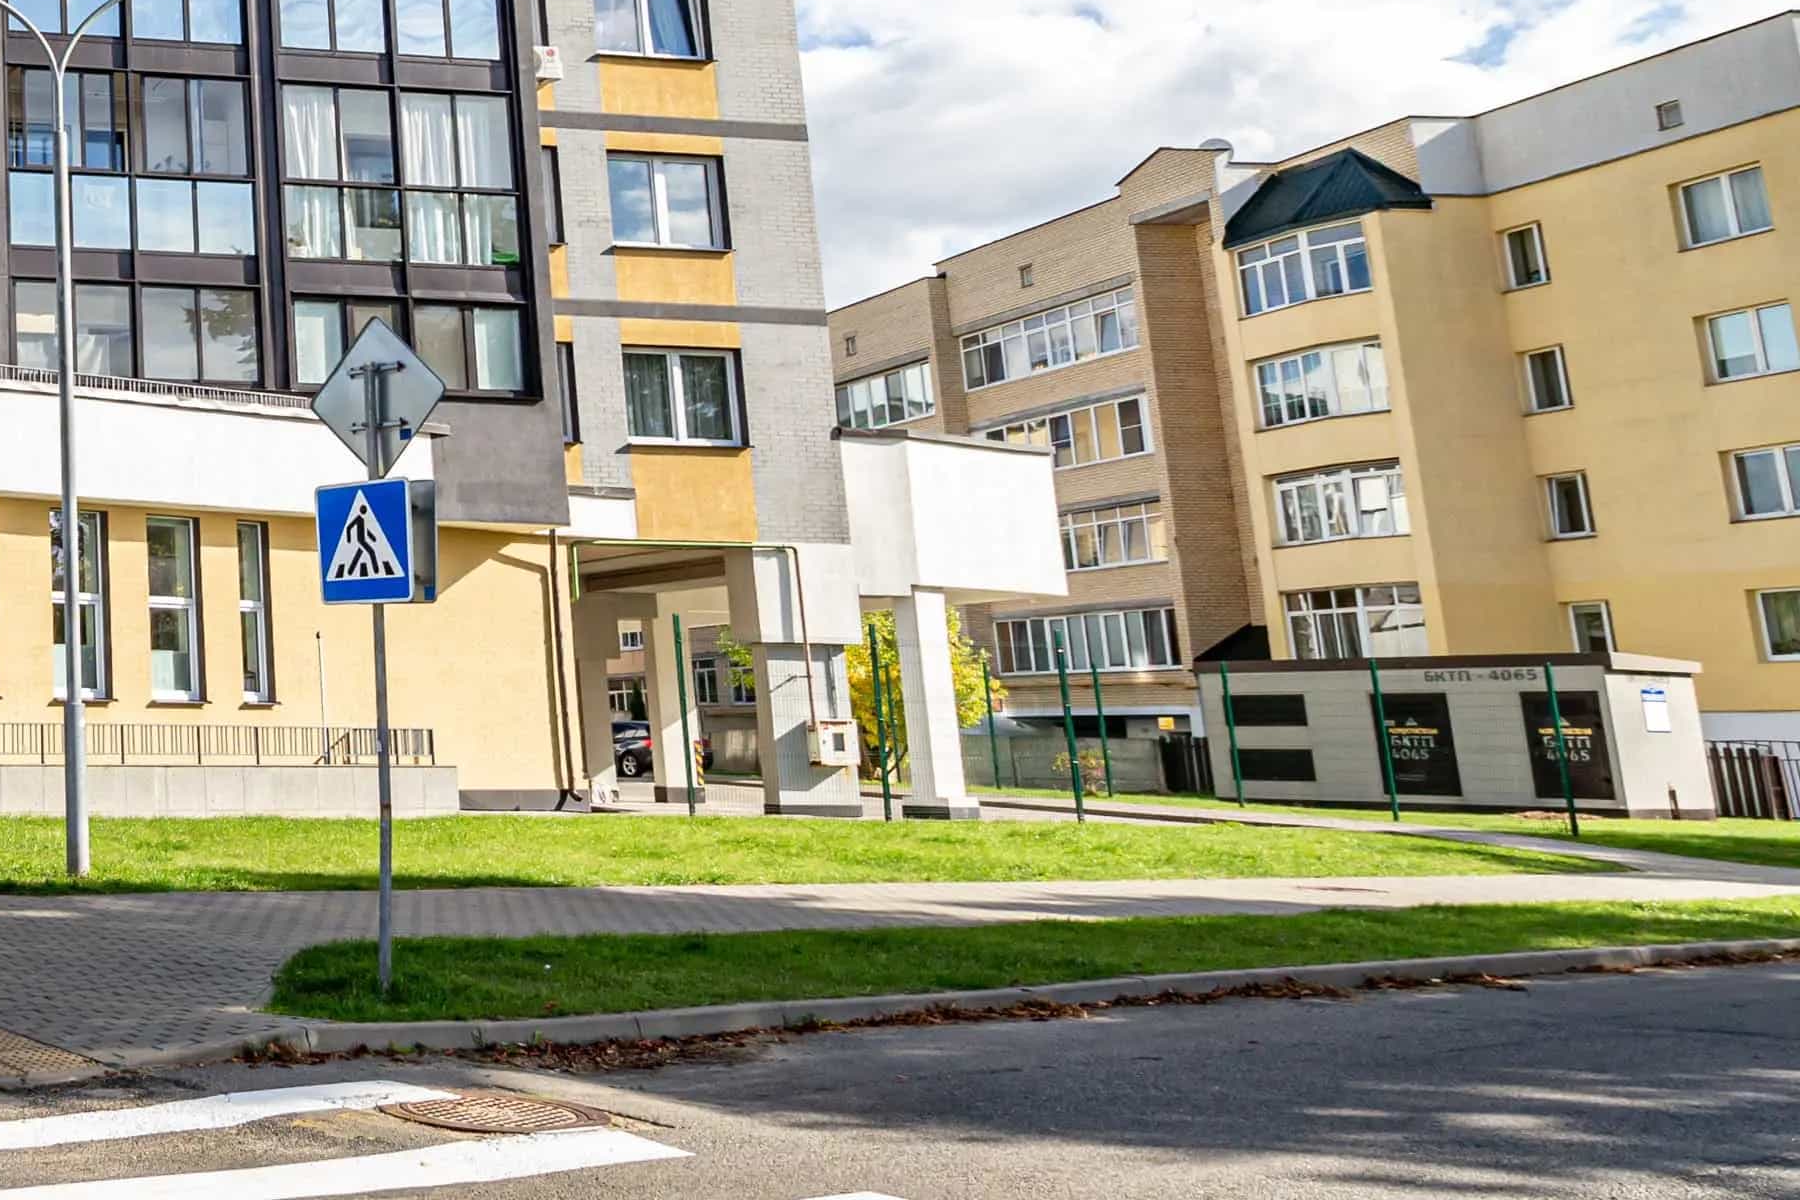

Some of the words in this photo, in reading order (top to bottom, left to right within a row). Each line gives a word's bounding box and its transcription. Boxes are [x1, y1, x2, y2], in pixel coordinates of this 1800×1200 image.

[1423, 670, 1472, 682] БКТП
[1488, 669, 1537, 681] 4065
[1391, 735, 1435, 748] БКТП
[1542, 736, 1592, 748] БТП
